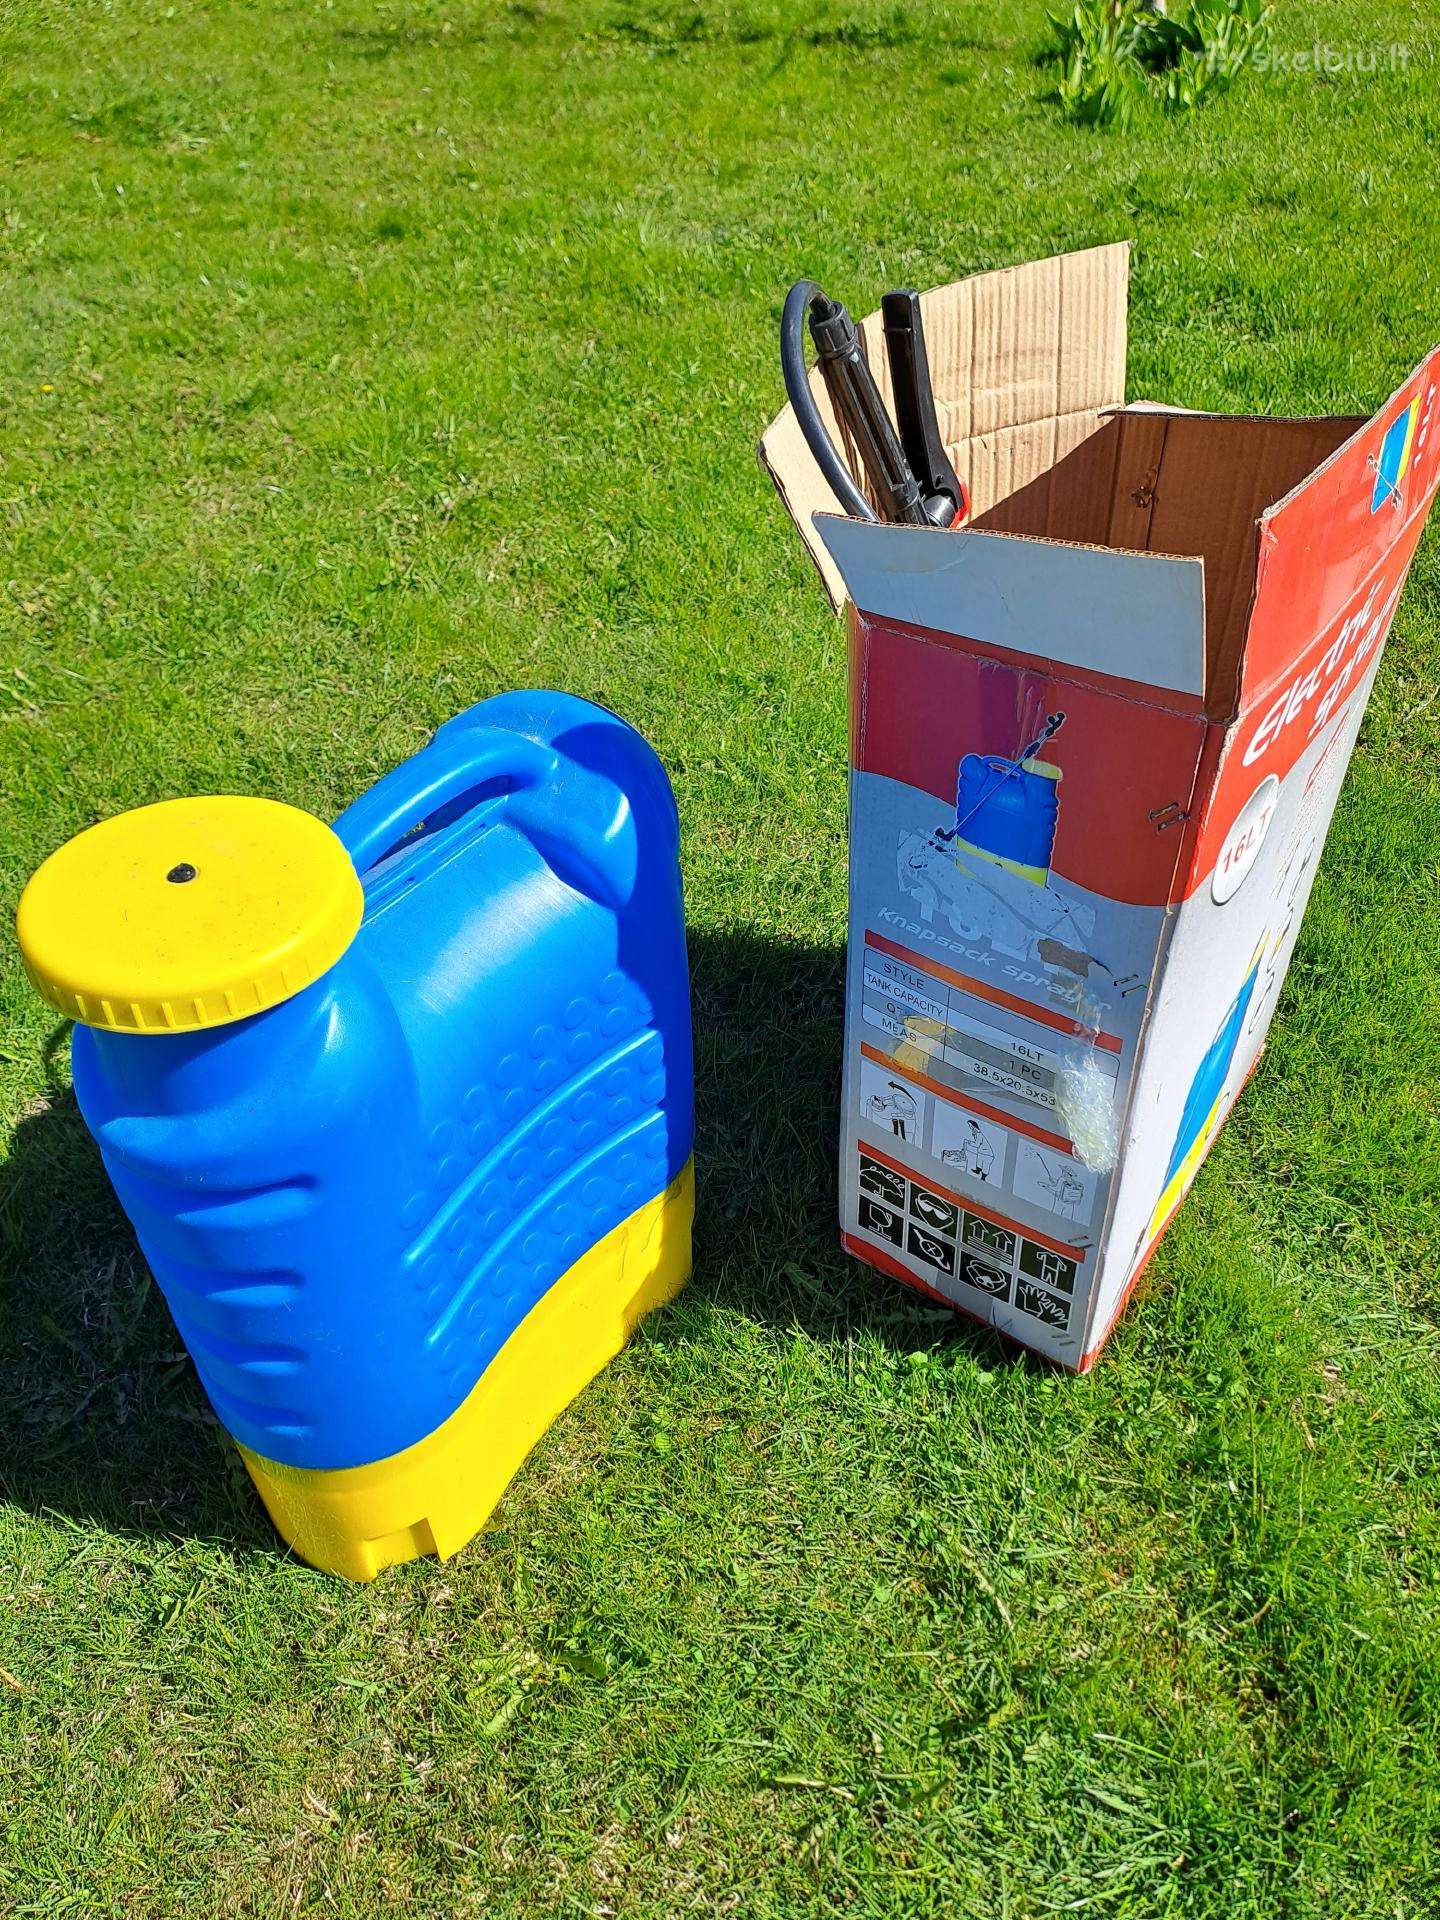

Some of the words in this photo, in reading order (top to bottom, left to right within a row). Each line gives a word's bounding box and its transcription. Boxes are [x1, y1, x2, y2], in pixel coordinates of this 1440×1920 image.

[1241, 575, 1385, 767] Electric
[1223, 806, 1271, 874] 16LT
[878, 906, 996, 968] Knapsack
[866, 972, 892, 993] TANK
[893, 987, 943, 1017] CAPACITY
[883, 963, 925, 990] STYLE
[882, 1018, 917, 1042] MEAS
[1009, 1060, 1015, 1070] 1
[1021, 1064, 1042, 1080] PC
[1010, 1042, 1044, 1062] 16LT
